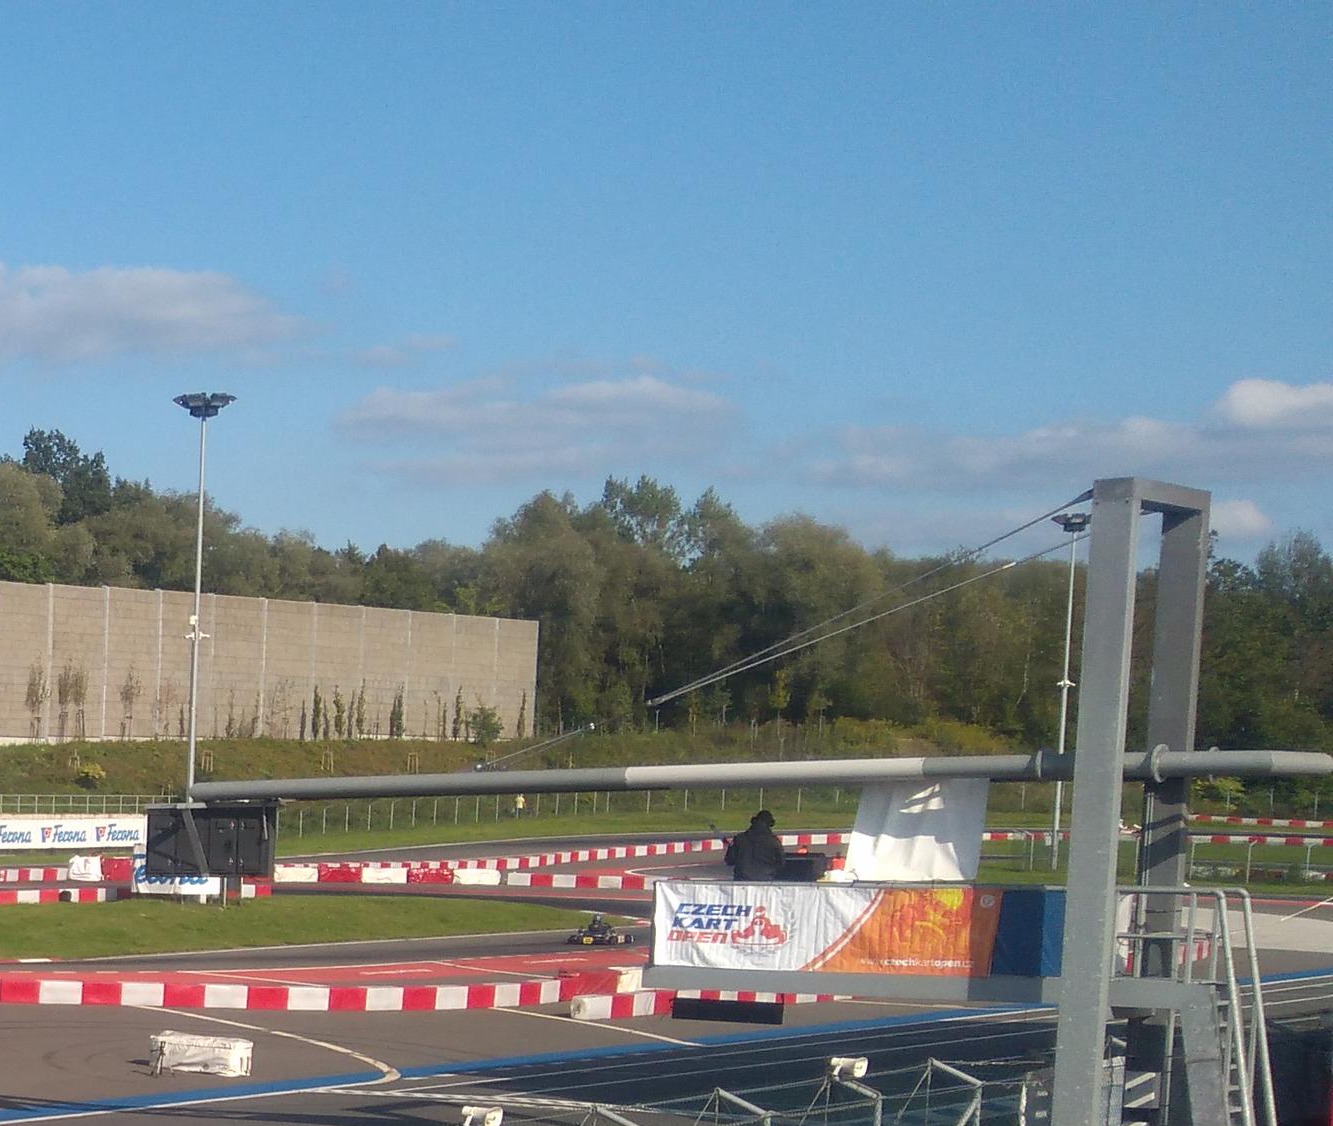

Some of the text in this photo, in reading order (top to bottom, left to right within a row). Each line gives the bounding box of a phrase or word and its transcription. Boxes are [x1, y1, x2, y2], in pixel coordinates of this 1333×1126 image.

[52, 824, 86, 843] Ferona
[107, 823, 139, 842] Ferona
[677, 903, 752, 917] CZECH
[672, 916, 739, 931] KART
[666, 930, 728, 944] OPEN
